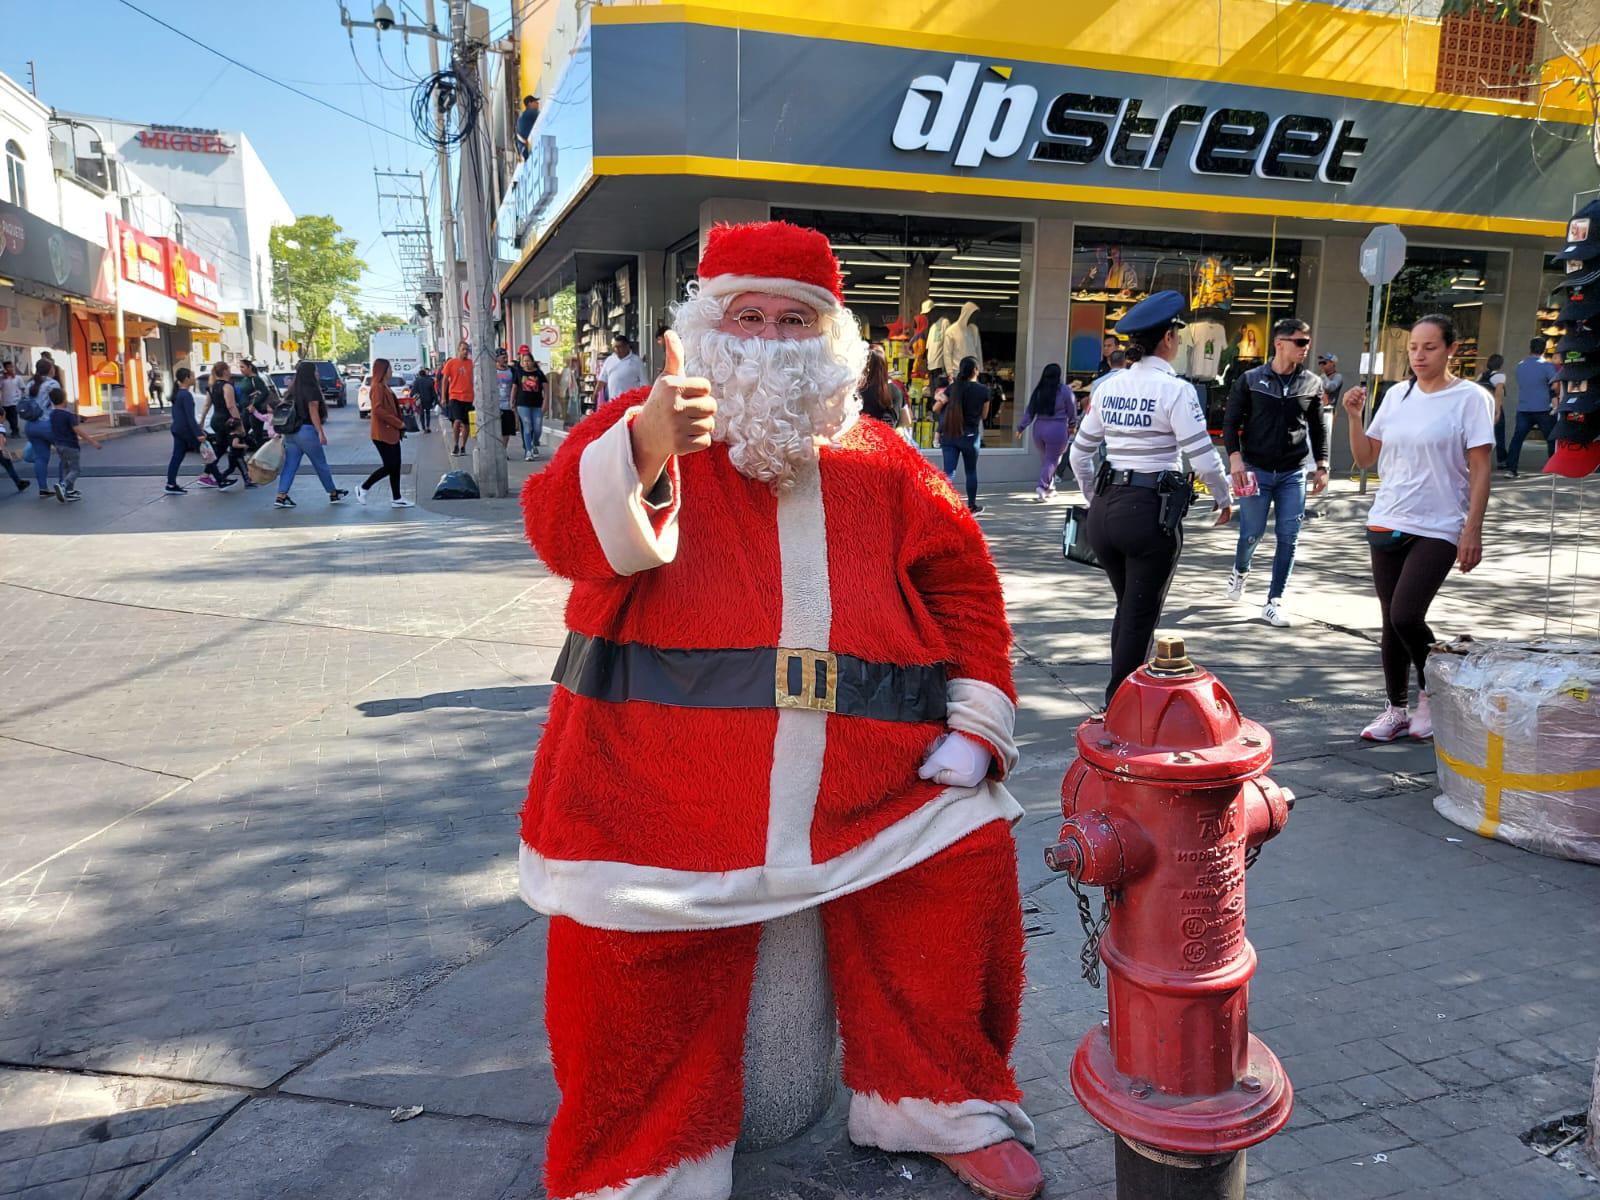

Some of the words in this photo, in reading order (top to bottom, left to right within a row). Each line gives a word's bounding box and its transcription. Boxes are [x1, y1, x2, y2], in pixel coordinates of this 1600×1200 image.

[1102, 396, 1138, 411] UNIDAD
[1139, 398, 1157, 412] DE
[1101, 411, 1152, 427] VIALIDAD
